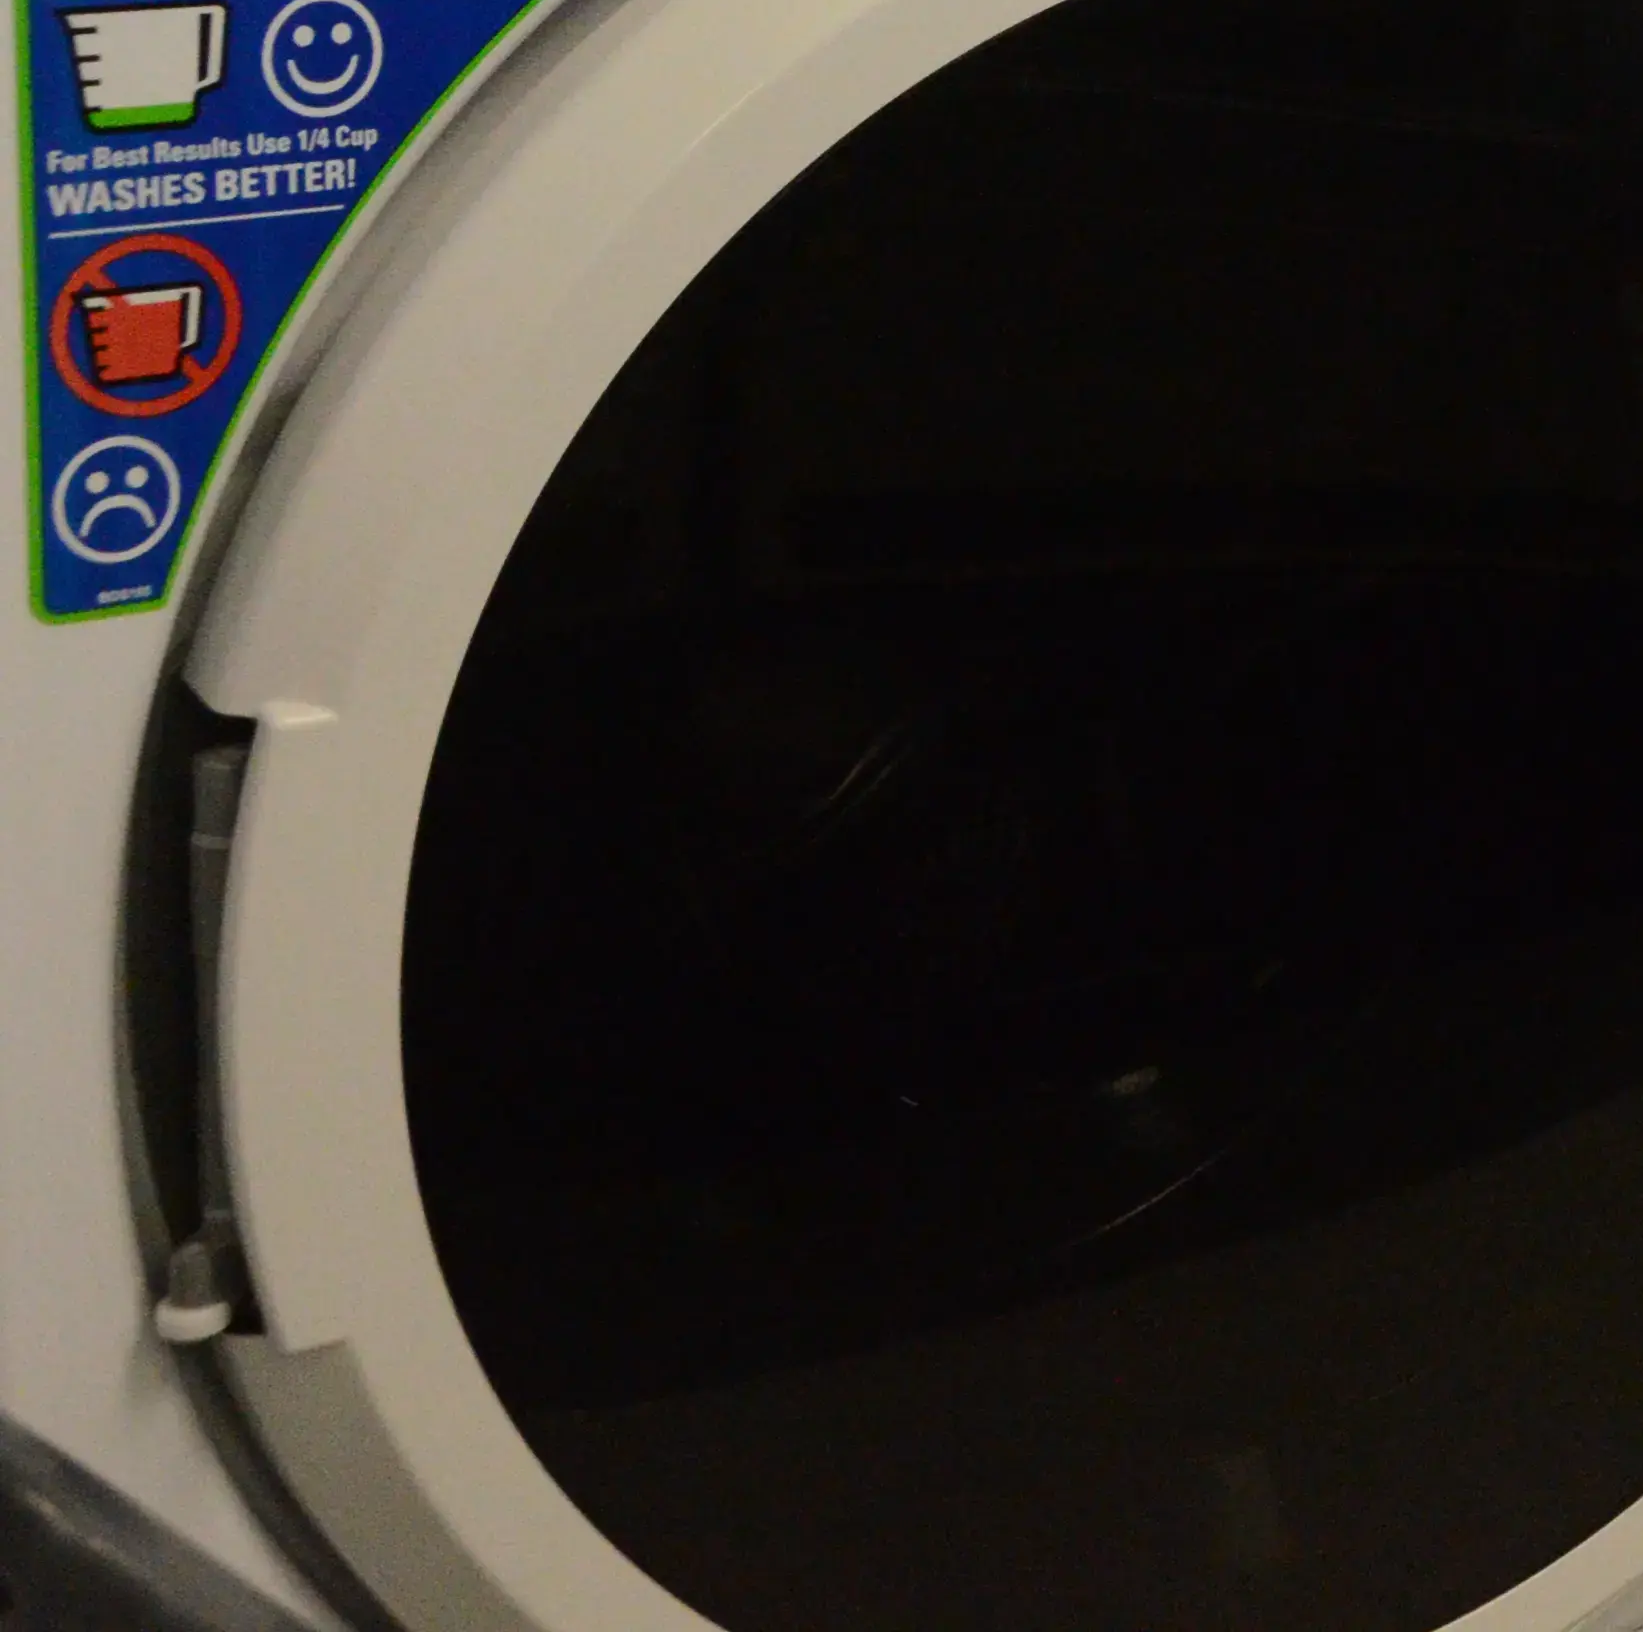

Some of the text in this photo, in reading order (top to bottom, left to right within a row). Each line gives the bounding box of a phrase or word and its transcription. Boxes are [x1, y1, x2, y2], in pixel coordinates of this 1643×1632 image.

[47, 124, 378, 175] For Best Results Use 1/4 Cup
[47, 158, 357, 217] WASHES BETTER!
